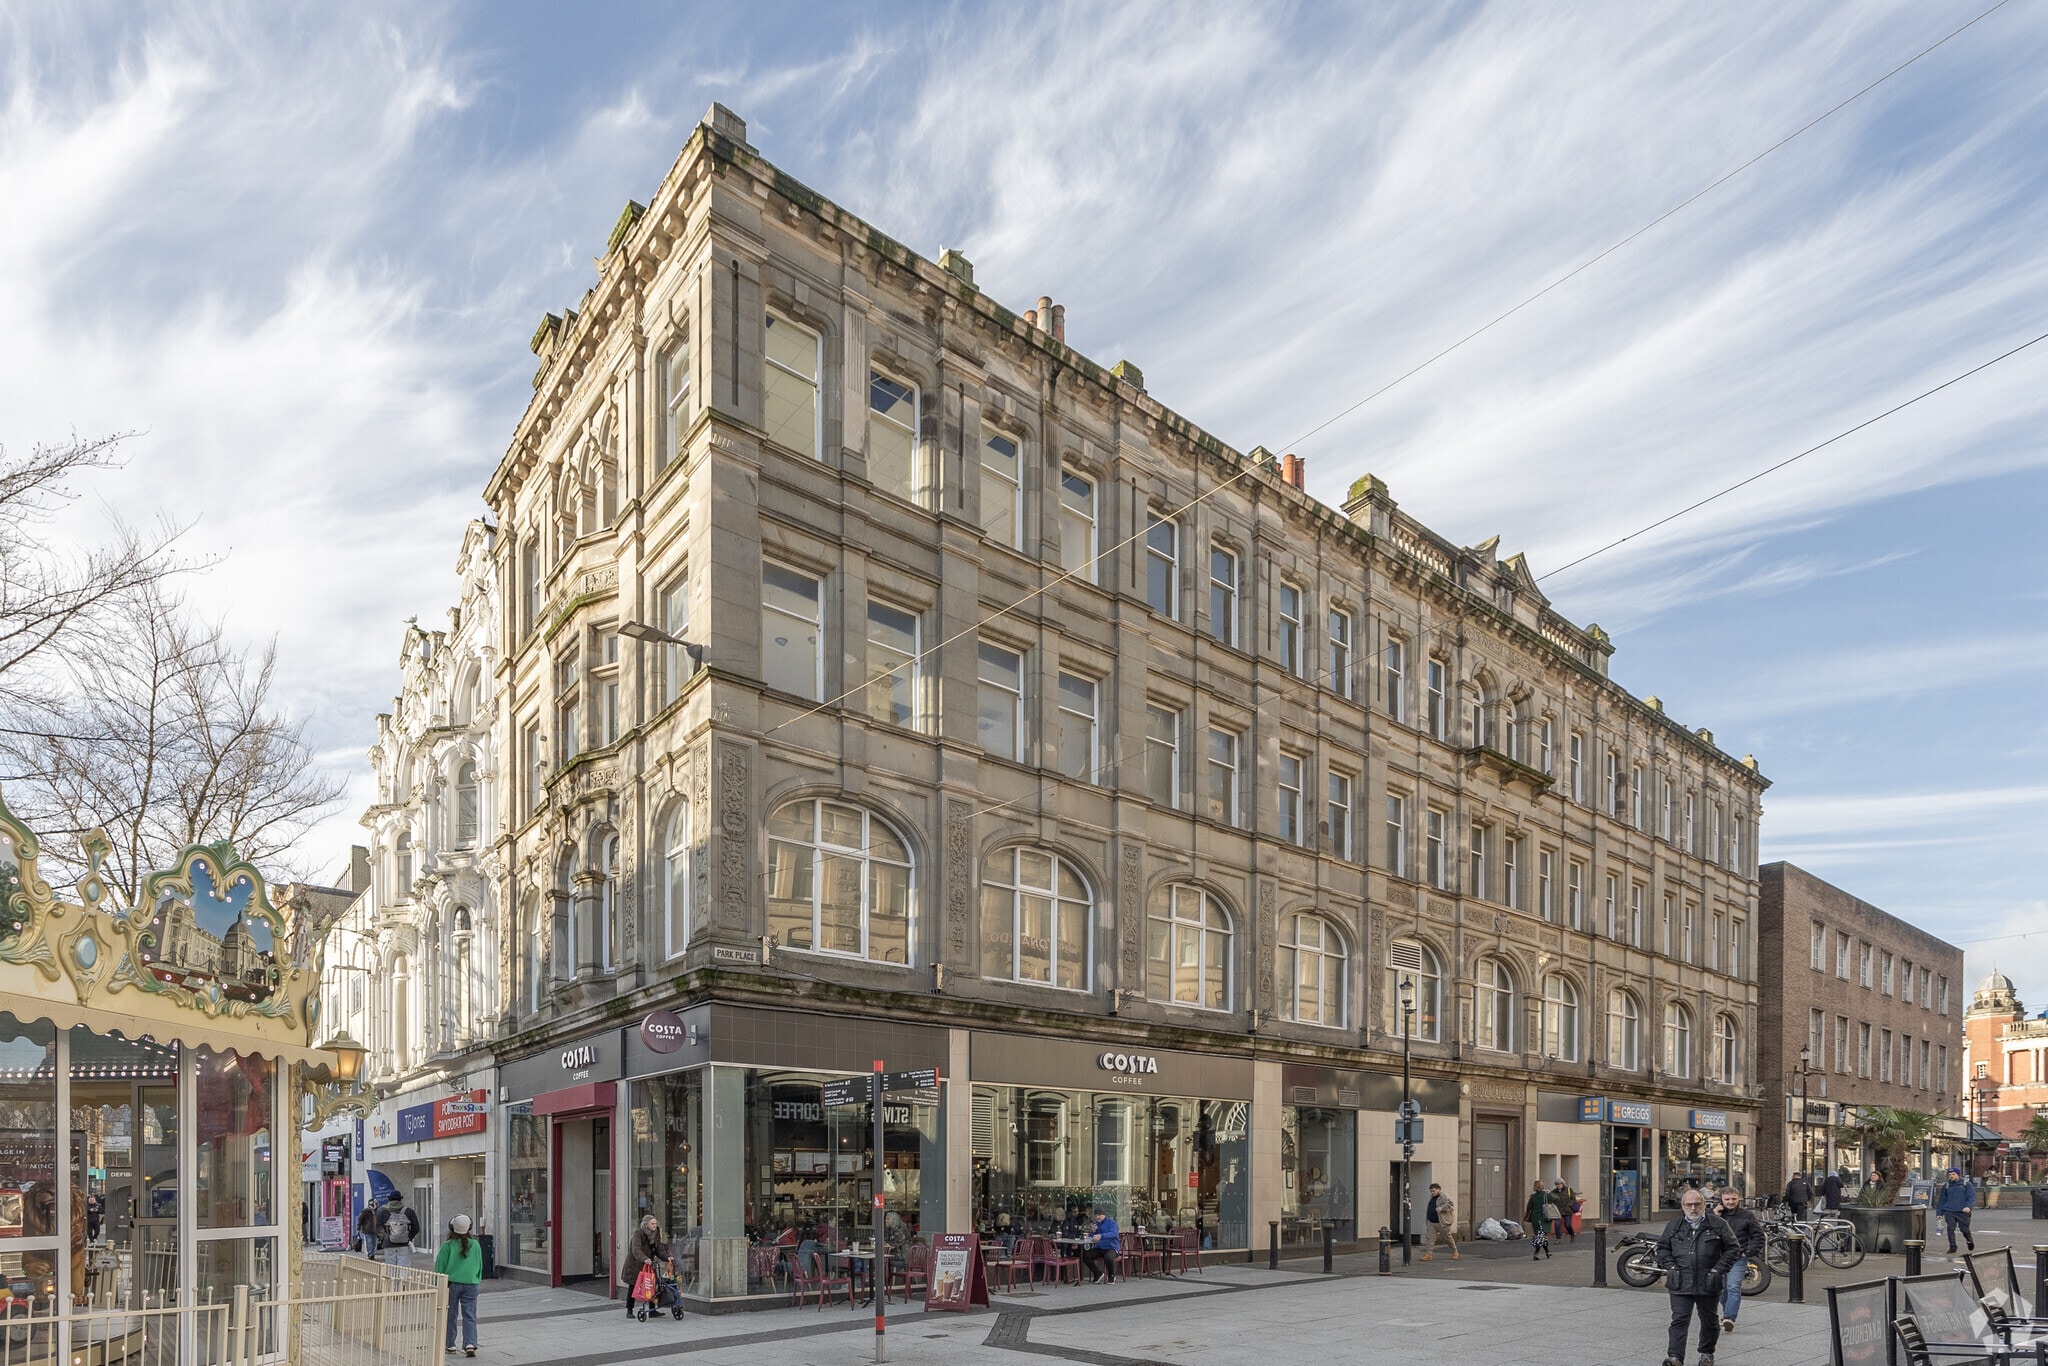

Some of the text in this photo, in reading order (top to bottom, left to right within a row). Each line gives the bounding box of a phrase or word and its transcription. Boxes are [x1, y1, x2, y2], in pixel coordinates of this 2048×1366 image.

[716, 949, 755, 961] PARK PLACE
[648, 1023, 682, 1035] COSTA
[561, 1045, 595, 1069] COSTA
[1101, 1052, 1158, 1074] COSTA
[572, 1070, 589, 1081] COFFEE
[1112, 1076, 1143, 1085] COFFEE
[1621, 1106, 1650, 1120] GREGGS
[462, 1113, 475, 1128] POST
[1701, 1114, 1726, 1127] GREGGS
